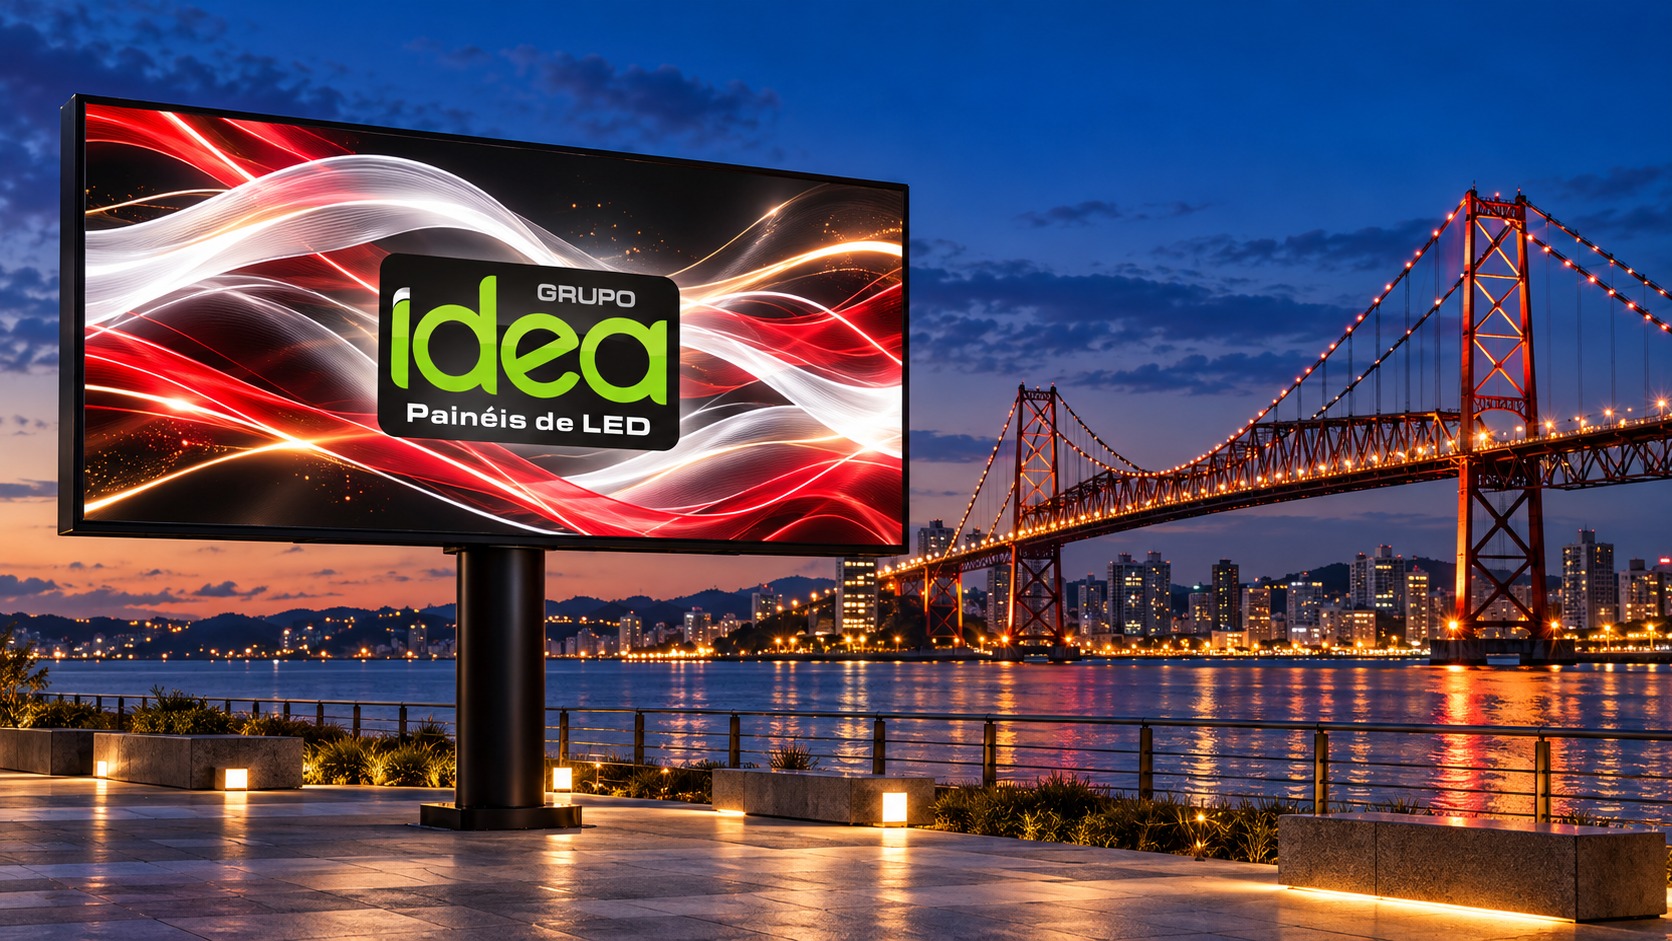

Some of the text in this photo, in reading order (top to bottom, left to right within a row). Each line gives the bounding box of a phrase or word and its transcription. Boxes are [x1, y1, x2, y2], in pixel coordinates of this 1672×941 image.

[537, 283, 636, 308] GRUPO
[391, 275, 668, 405] idea
[406, 402, 651, 436] Painéis de LED
